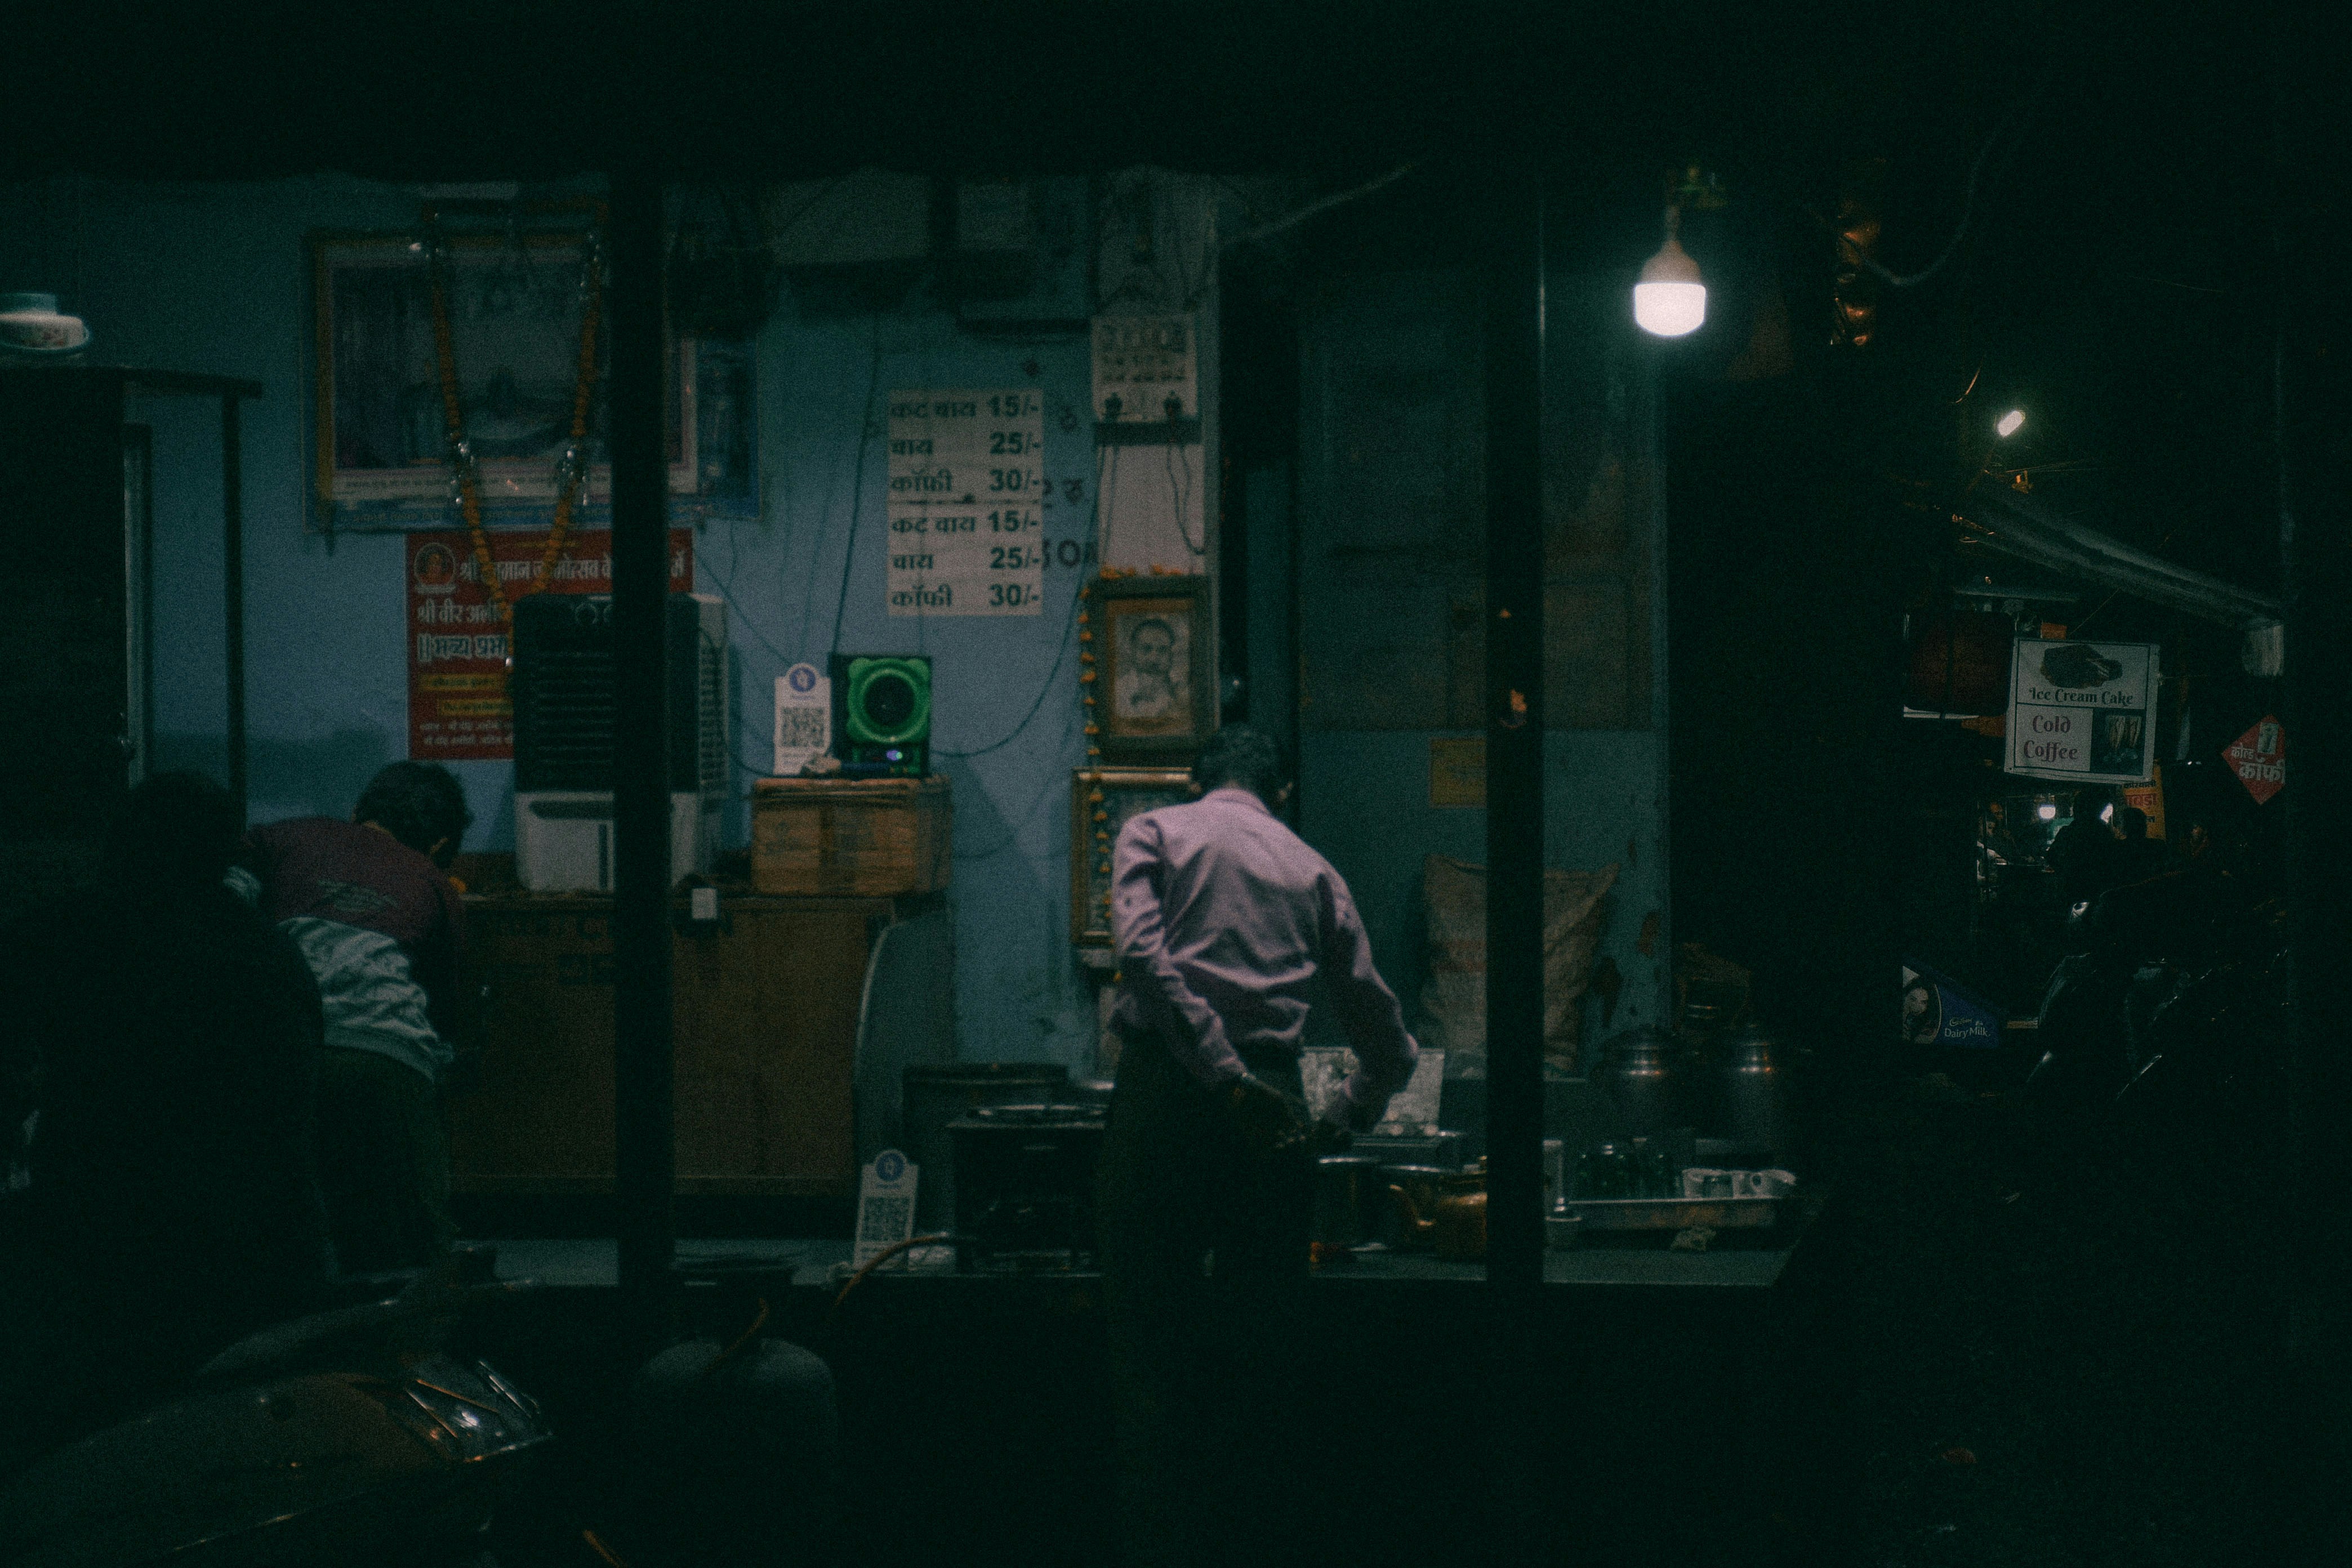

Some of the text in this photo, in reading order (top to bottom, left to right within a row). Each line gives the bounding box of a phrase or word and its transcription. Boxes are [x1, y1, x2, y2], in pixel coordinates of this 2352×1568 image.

[988, 395, 1039, 417] 15/-
[990, 433, 1039, 455] 25/-
[891, 469, 952, 492] कॉफी
[990, 469, 1040, 492] 30/-
[892, 516, 928, 533] कट
[988, 511, 1038, 532] 15/-
[990, 547, 1039, 569] 25/-
[892, 583, 1039, 607] कॉफी 30/-
[2029, 687, 2133, 706] Ice Cream Cake
[2032, 715, 2071, 734] Cold
[2023, 740, 2079, 763] Coffee
[2231, 742, 2255, 759] कोल्ड
[1944, 1026, 1990, 1040] Dairy Milk
